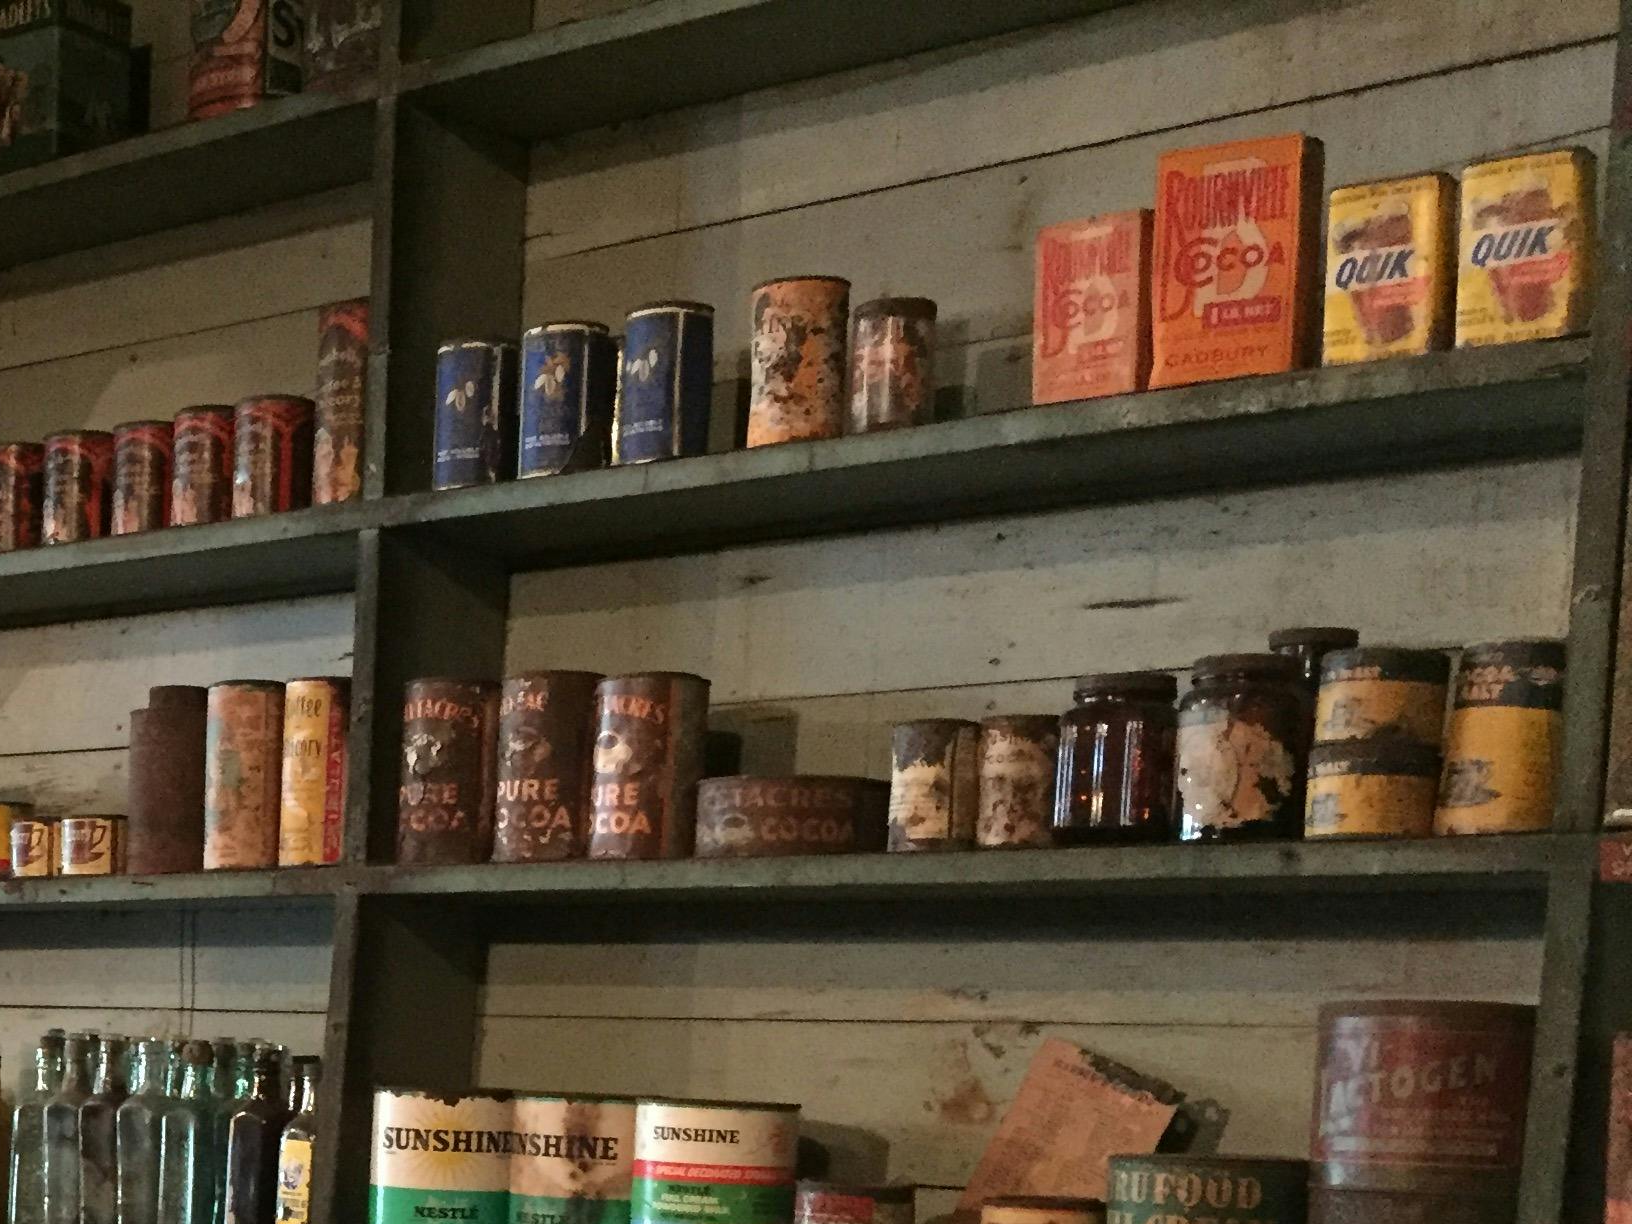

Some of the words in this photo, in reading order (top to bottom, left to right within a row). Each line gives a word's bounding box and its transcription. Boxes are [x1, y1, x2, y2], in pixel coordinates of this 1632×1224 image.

[1471, 226, 1554, 268] QUIK
[1173, 237, 1285, 288] COCOA
[1335, 249, 1415, 291] QUIK
[1165, 345, 1269, 368] CADBURY
[383, 1126, 515, 1153] SUNSHINE
[508, 1131, 619, 1161] NSHINE
[653, 1126, 741, 1145] SUNSHINE
[414, 1204, 481, 1221] NESTLÉ
